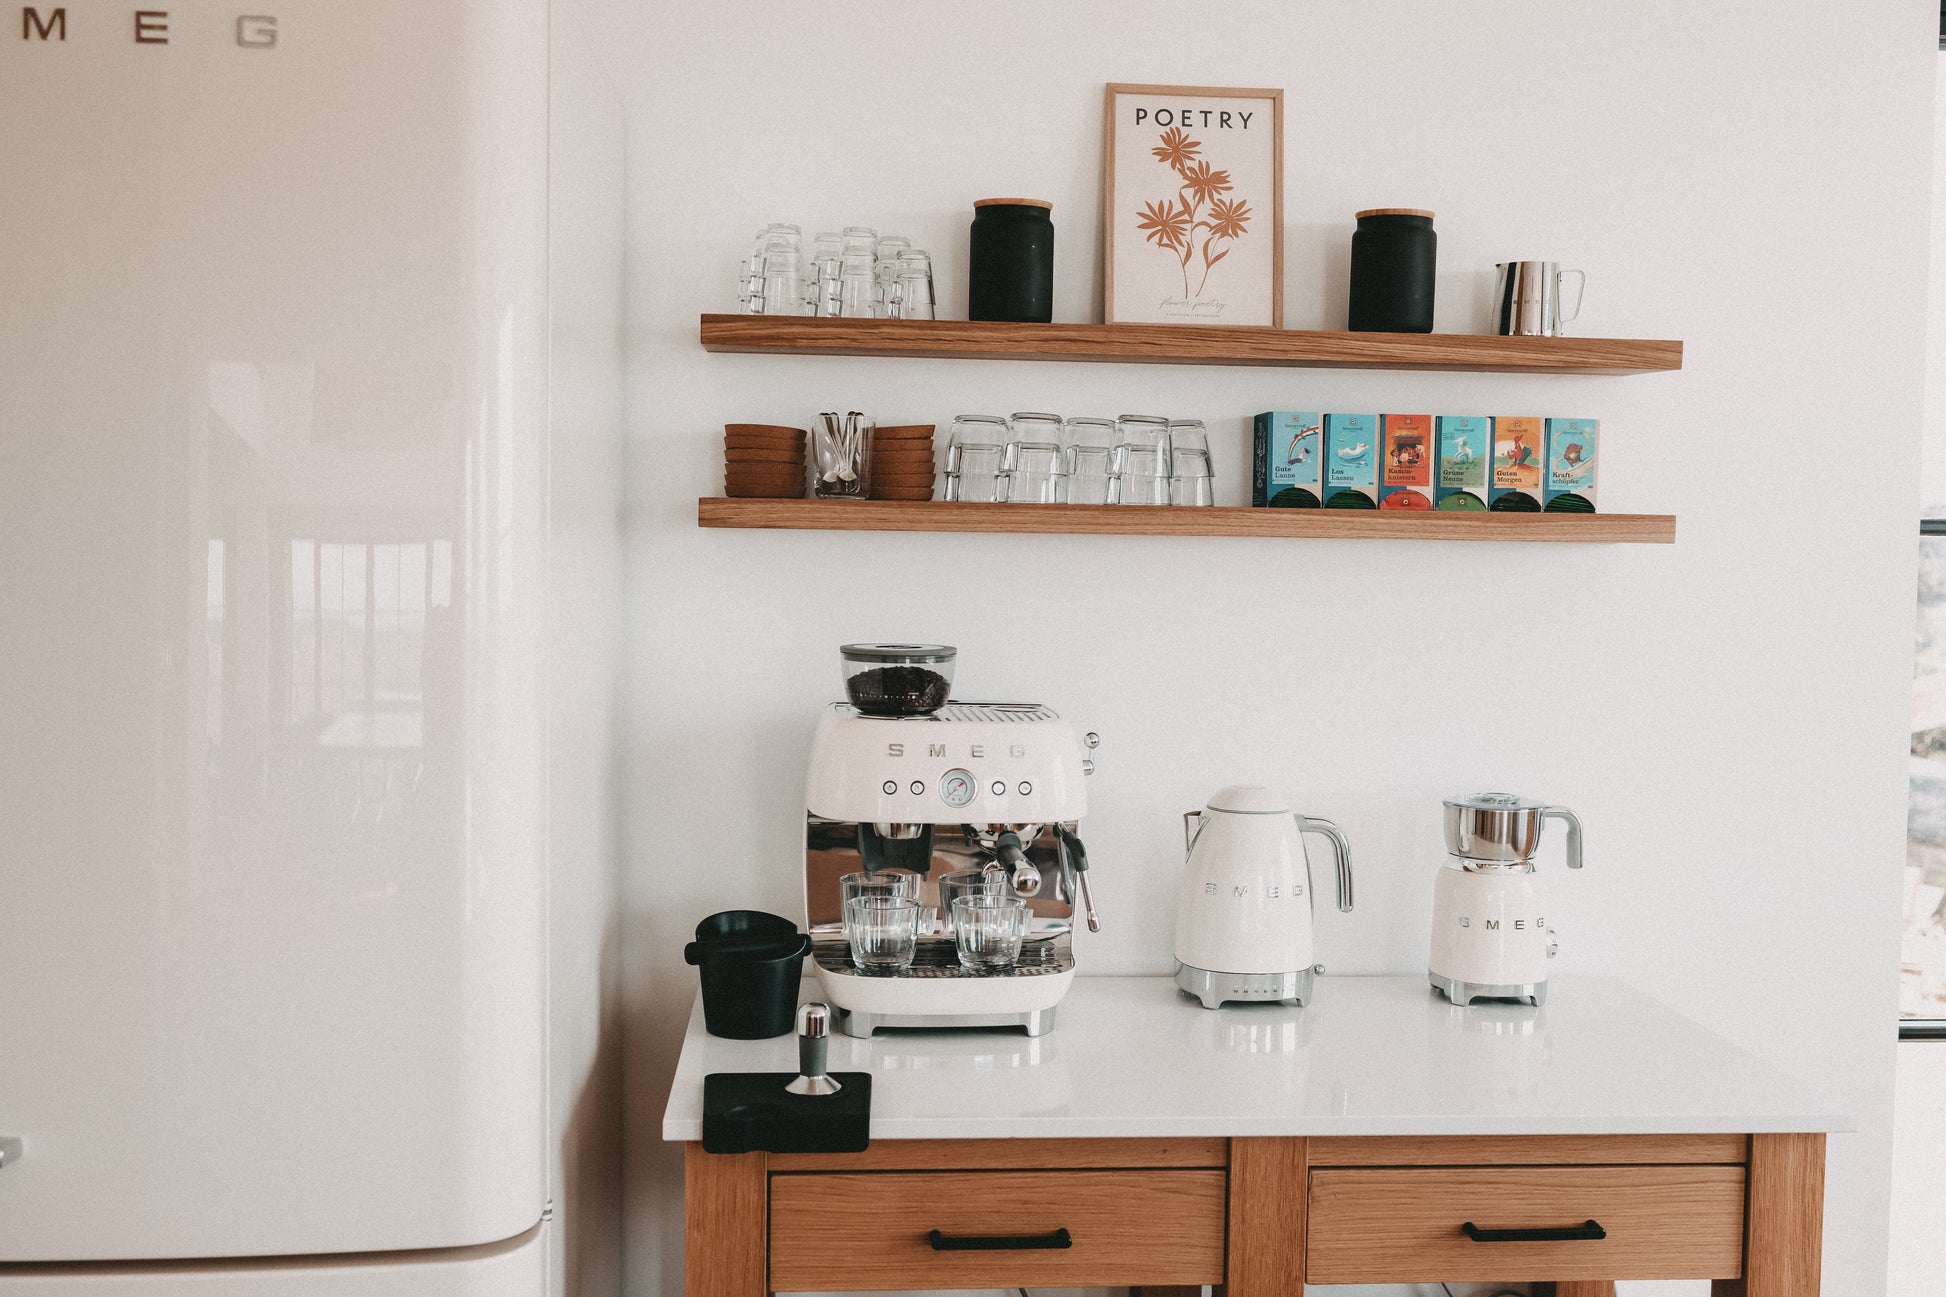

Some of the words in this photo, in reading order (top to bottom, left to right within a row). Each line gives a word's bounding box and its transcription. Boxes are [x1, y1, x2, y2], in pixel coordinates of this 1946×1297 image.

[1136, 108, 1253, 129] POETRY
[888, 743, 1026, 759] SMEG
[1458, 917, 1545, 930] SMEG
